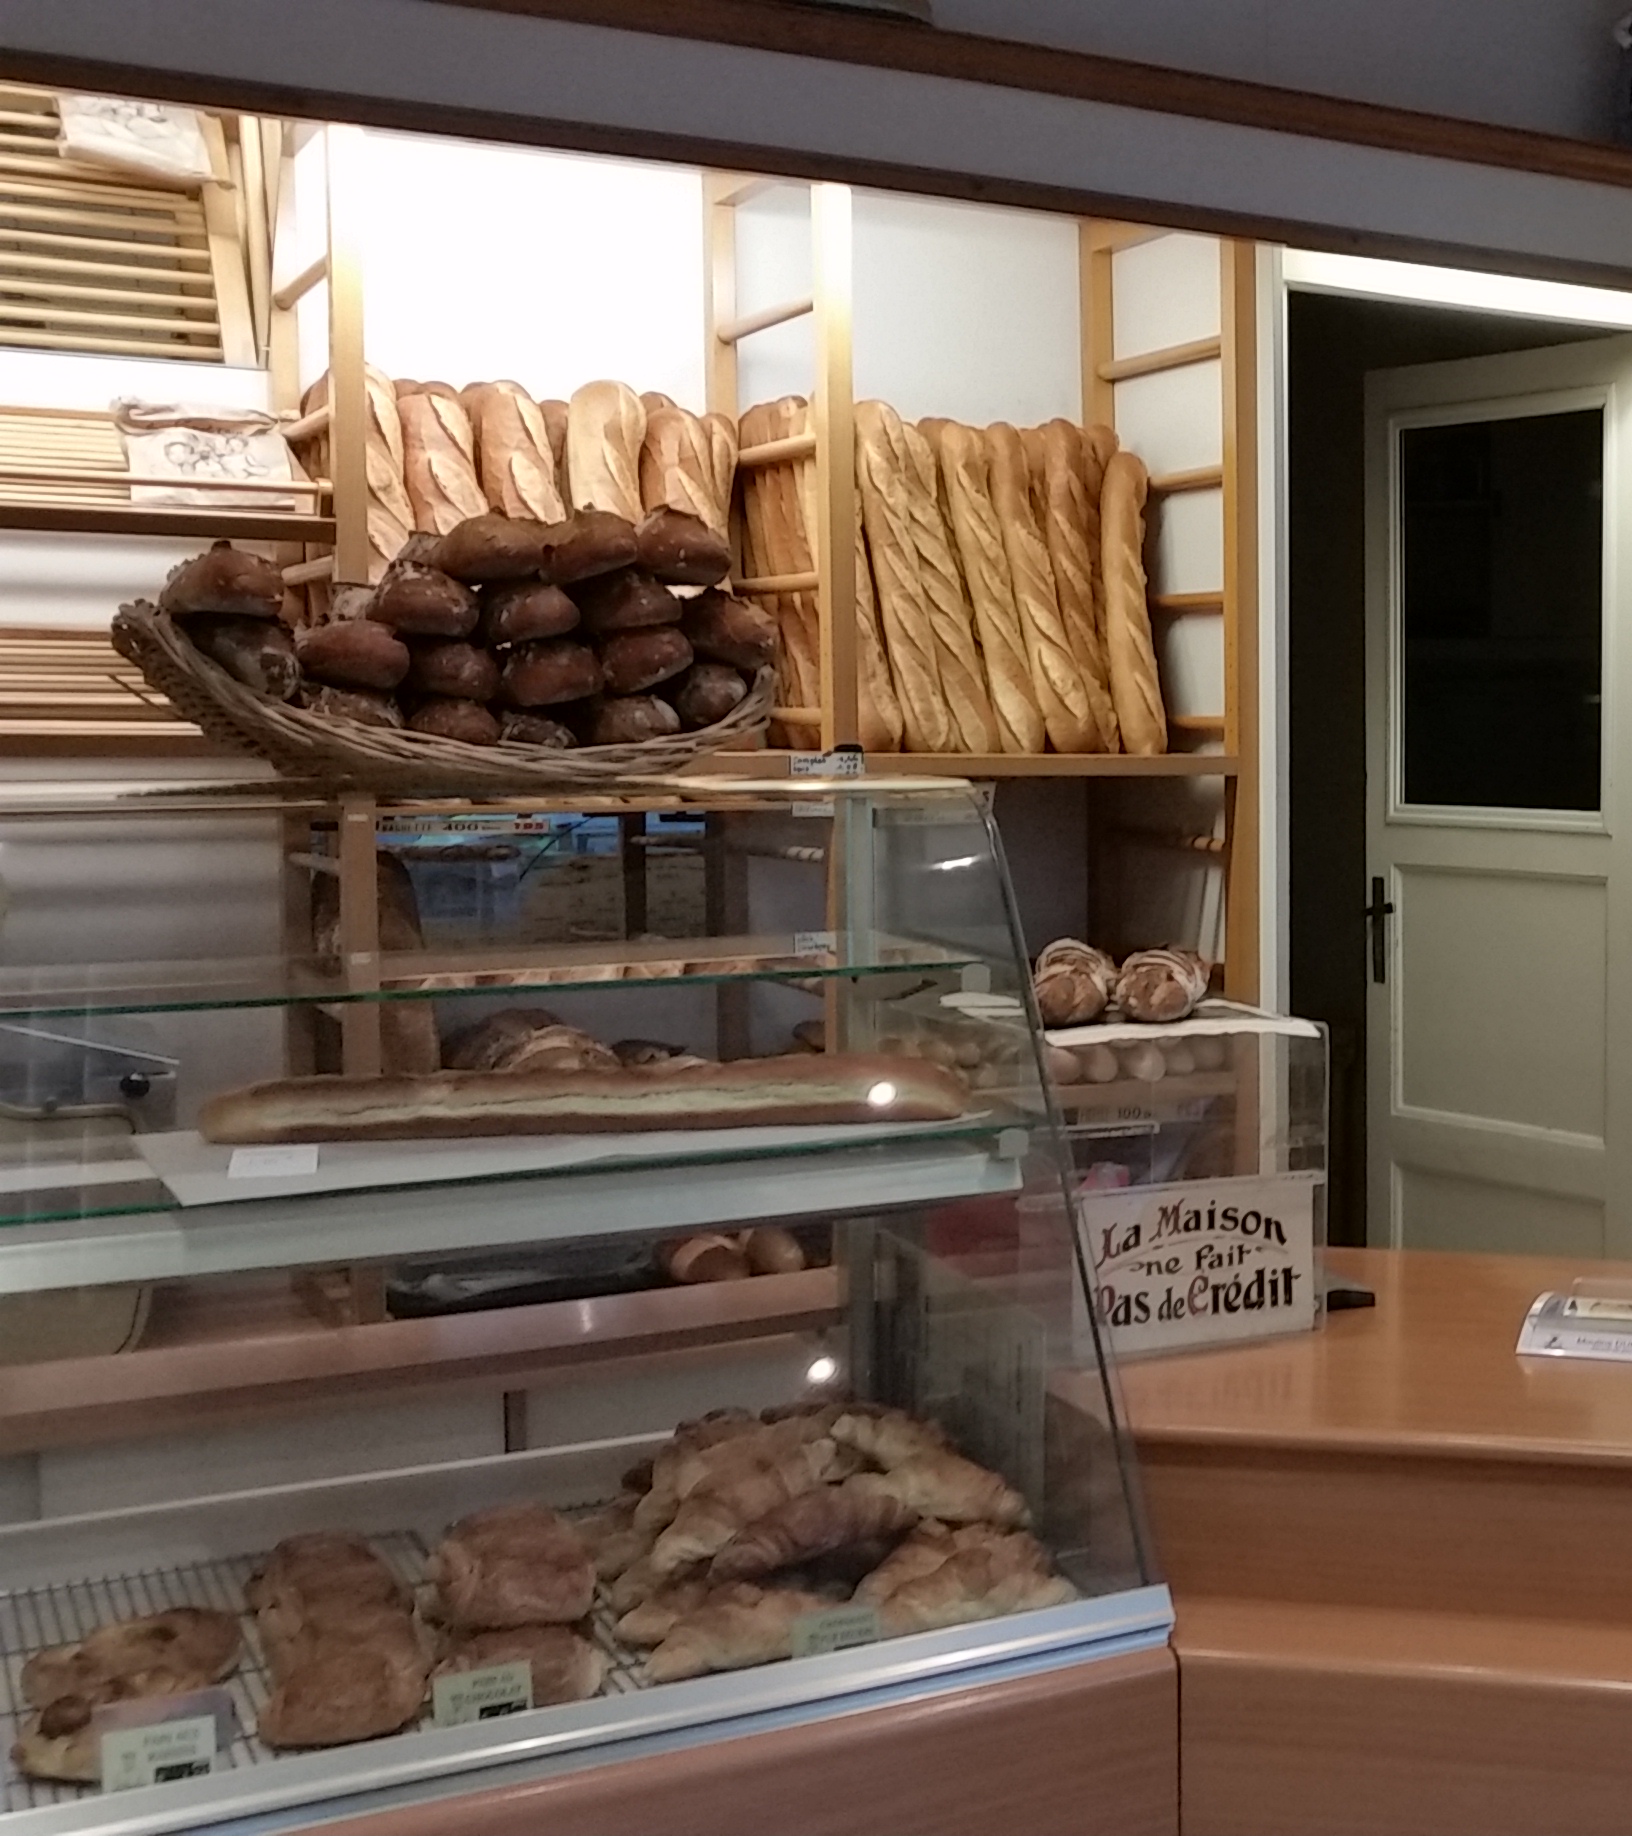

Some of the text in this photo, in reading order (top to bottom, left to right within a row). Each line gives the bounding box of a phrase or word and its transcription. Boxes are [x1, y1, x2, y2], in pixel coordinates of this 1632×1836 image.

[1096, 1198, 1287, 1269] La Maison
[1094, 1265, 1302, 1327] Pas de Crédit
[1145, 1255, 1184, 1277] ne
